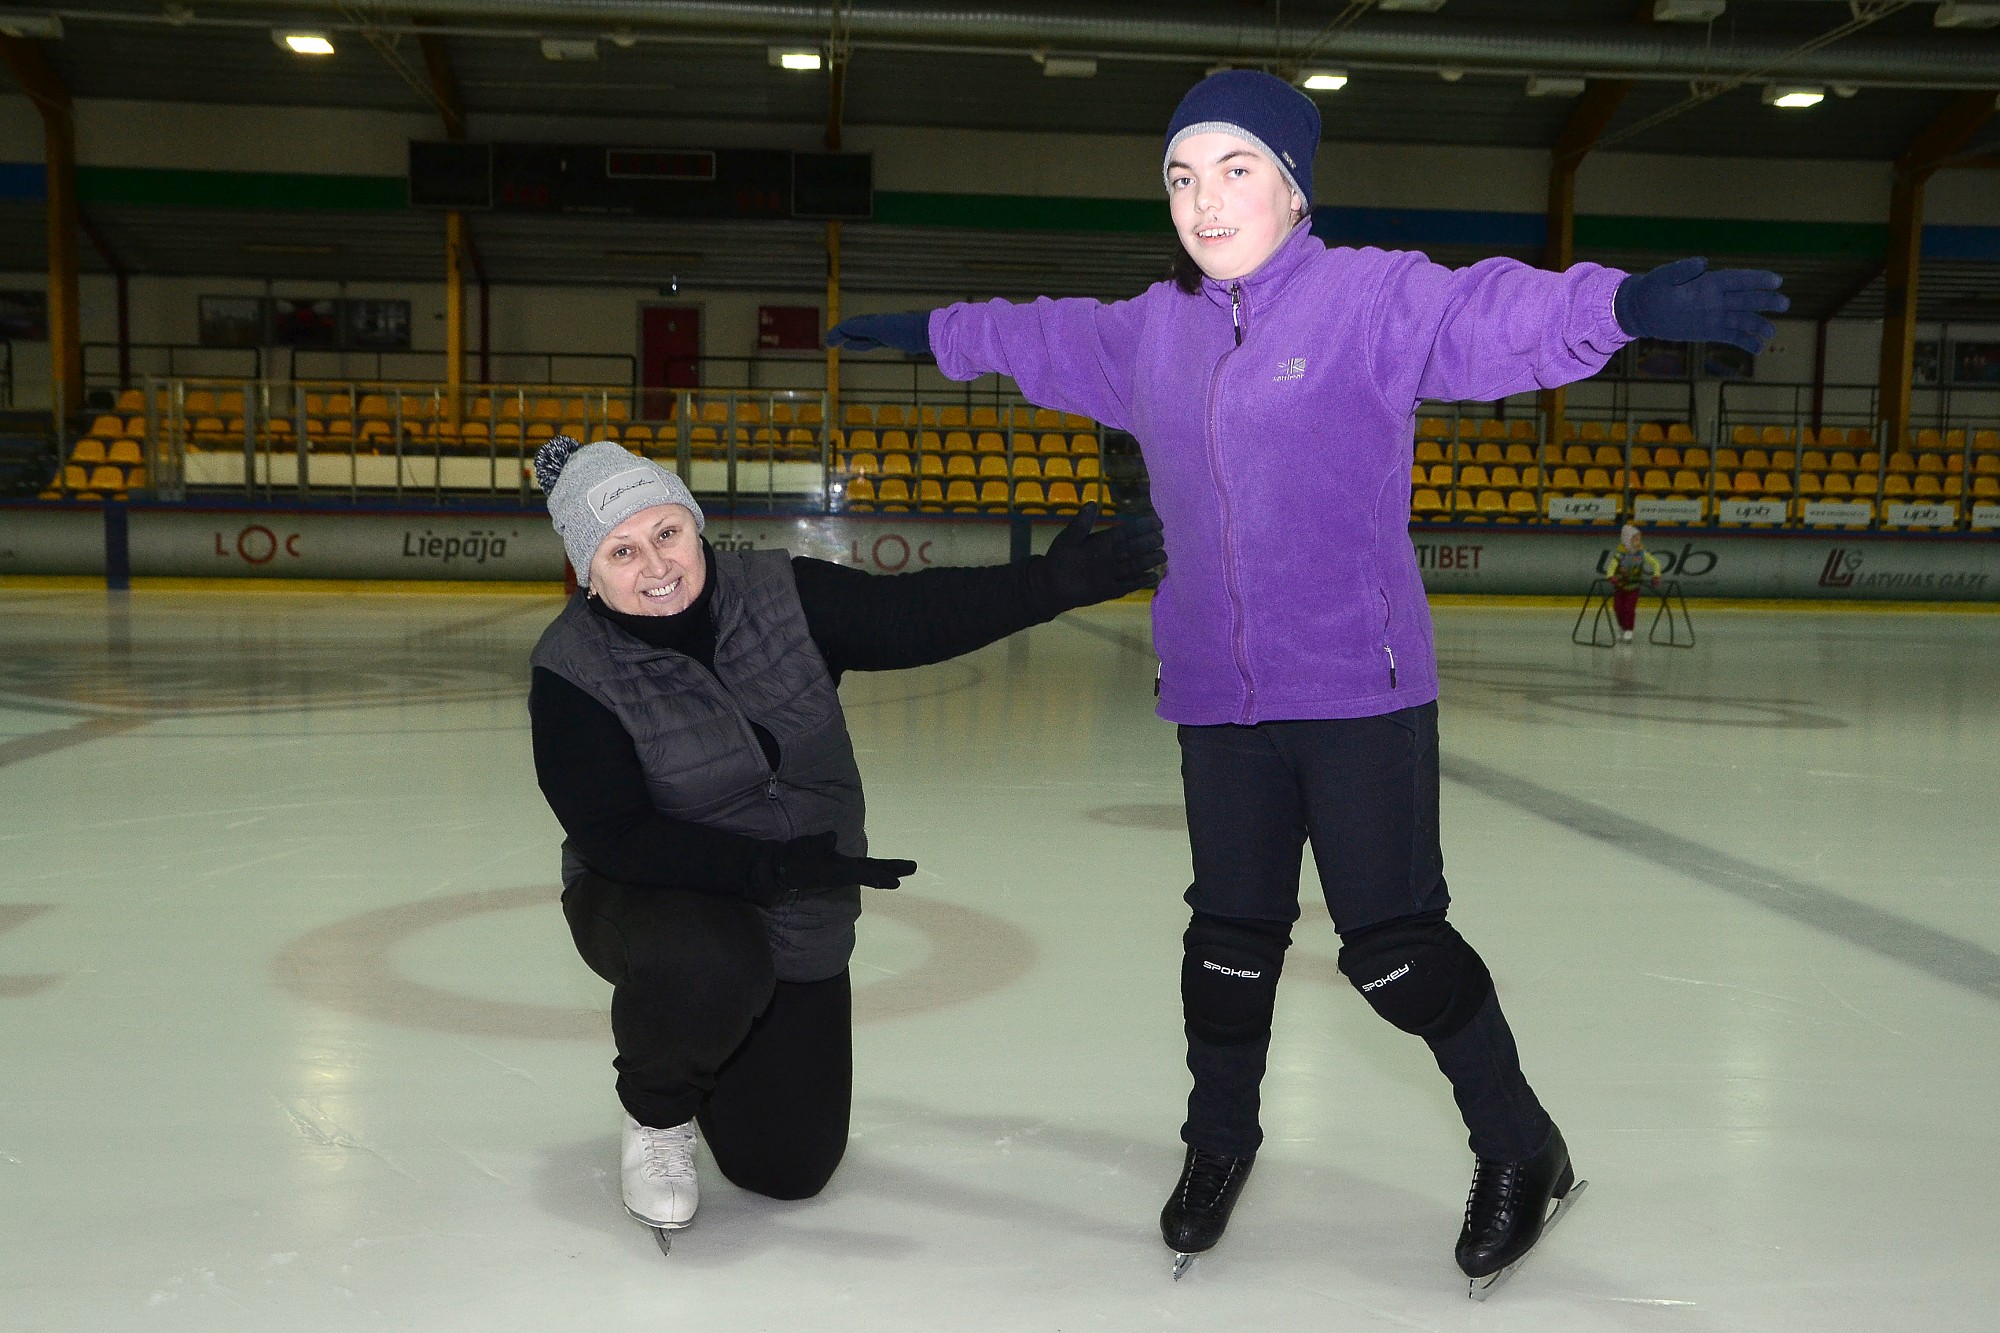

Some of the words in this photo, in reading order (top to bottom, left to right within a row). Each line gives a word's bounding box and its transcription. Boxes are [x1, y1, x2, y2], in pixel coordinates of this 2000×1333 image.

[216, 525, 300, 564] LOC
[403, 530, 507, 564] Liepāja
[853, 534, 932, 571] LOC
